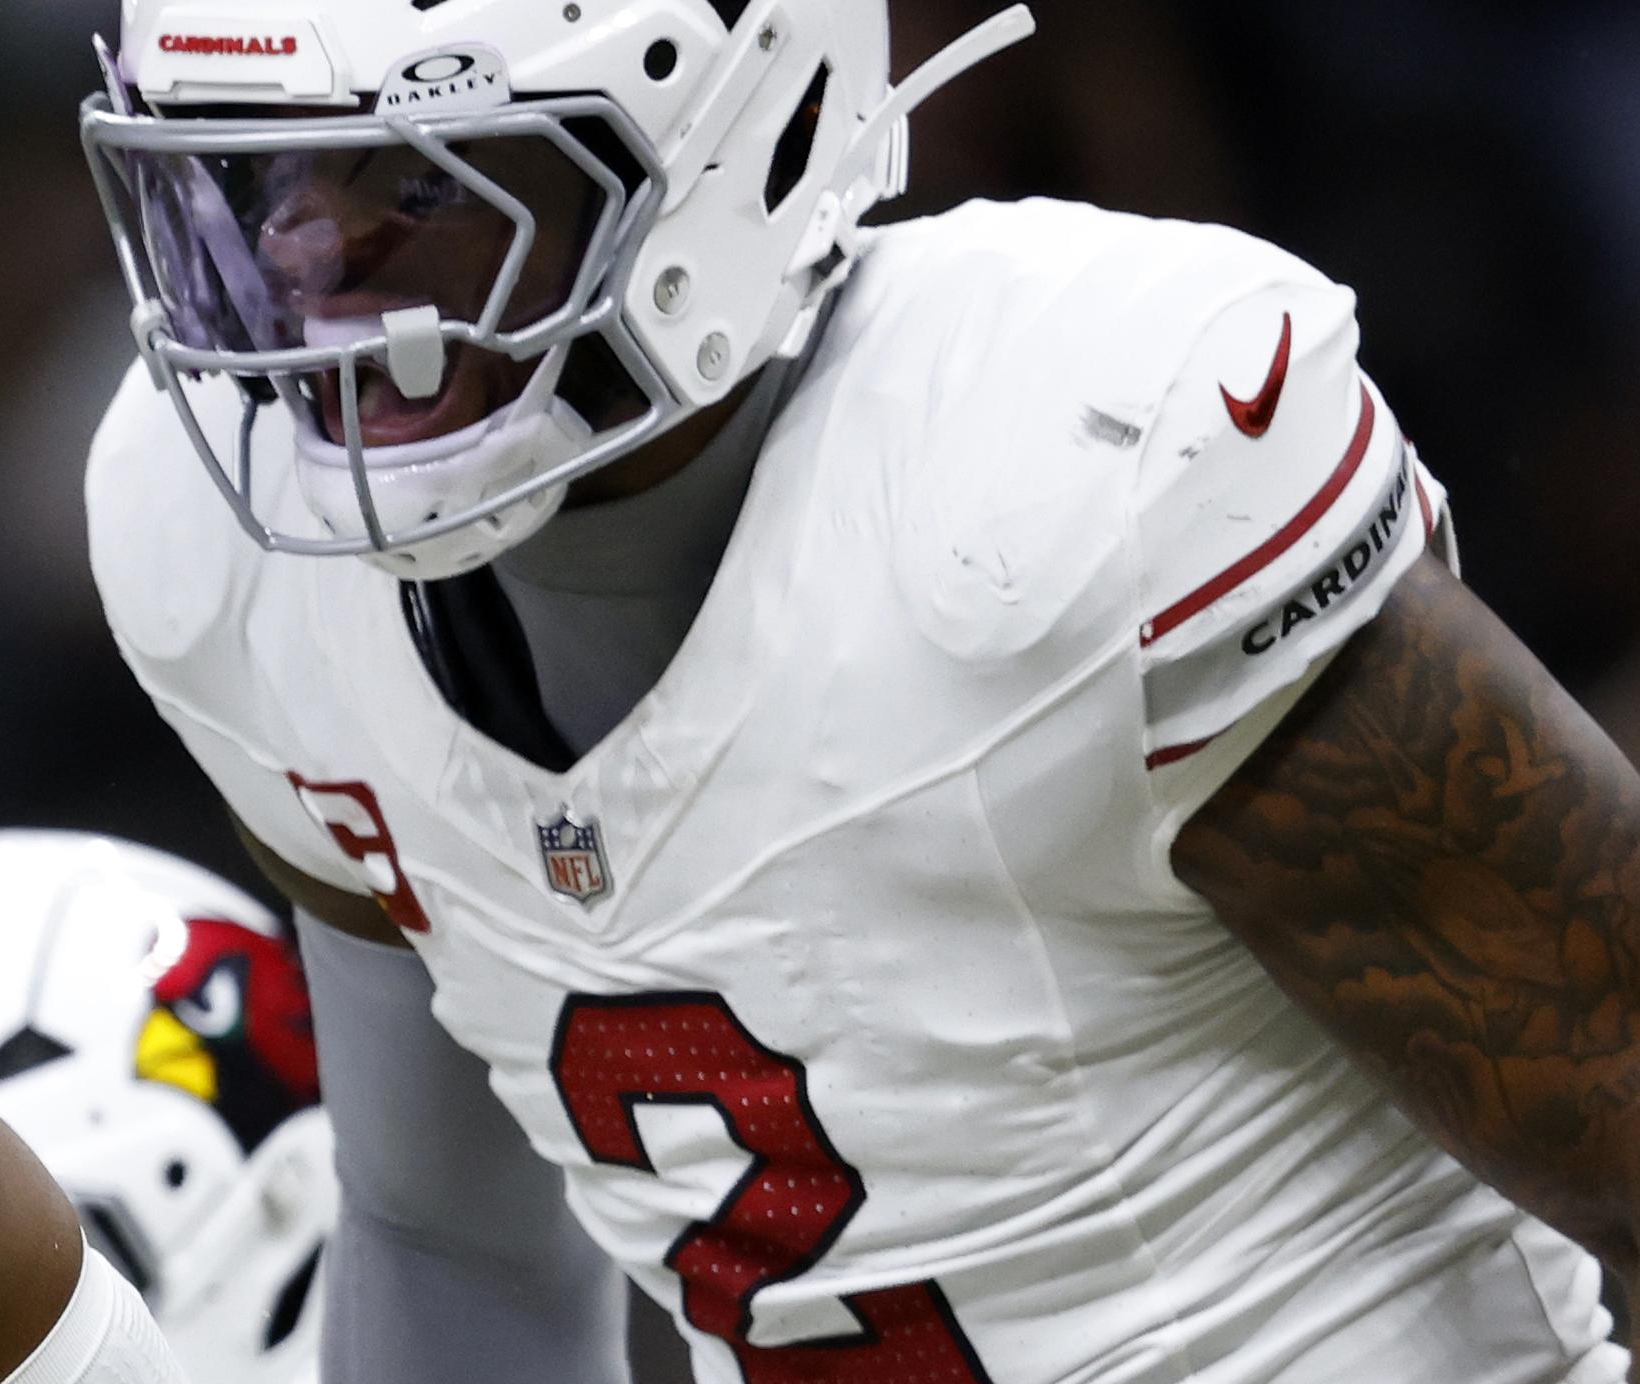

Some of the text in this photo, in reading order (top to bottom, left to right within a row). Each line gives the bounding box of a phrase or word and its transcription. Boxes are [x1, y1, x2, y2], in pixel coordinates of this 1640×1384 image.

[159, 34, 297, 56] CARDINALS
[386, 73, 496, 105] OAKLEY
[549, 852, 602, 892] NFL
